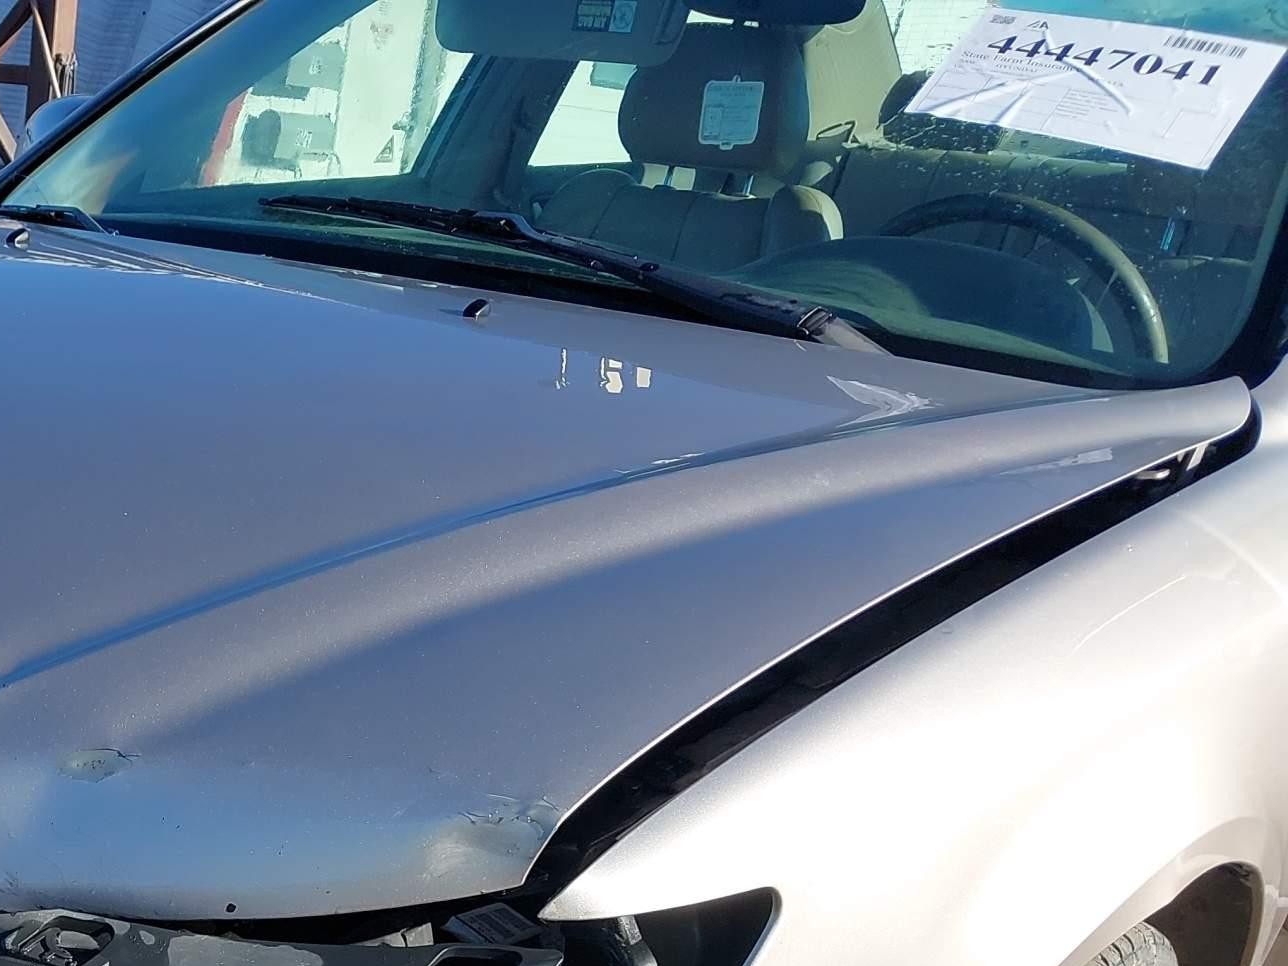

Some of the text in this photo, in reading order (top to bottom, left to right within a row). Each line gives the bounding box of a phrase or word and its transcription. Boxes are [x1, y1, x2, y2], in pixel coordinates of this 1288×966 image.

[961, 50, 990, 60] State
[993, 55, 1023, 65] Farm
[987, 35, 1222, 86] 44447041
